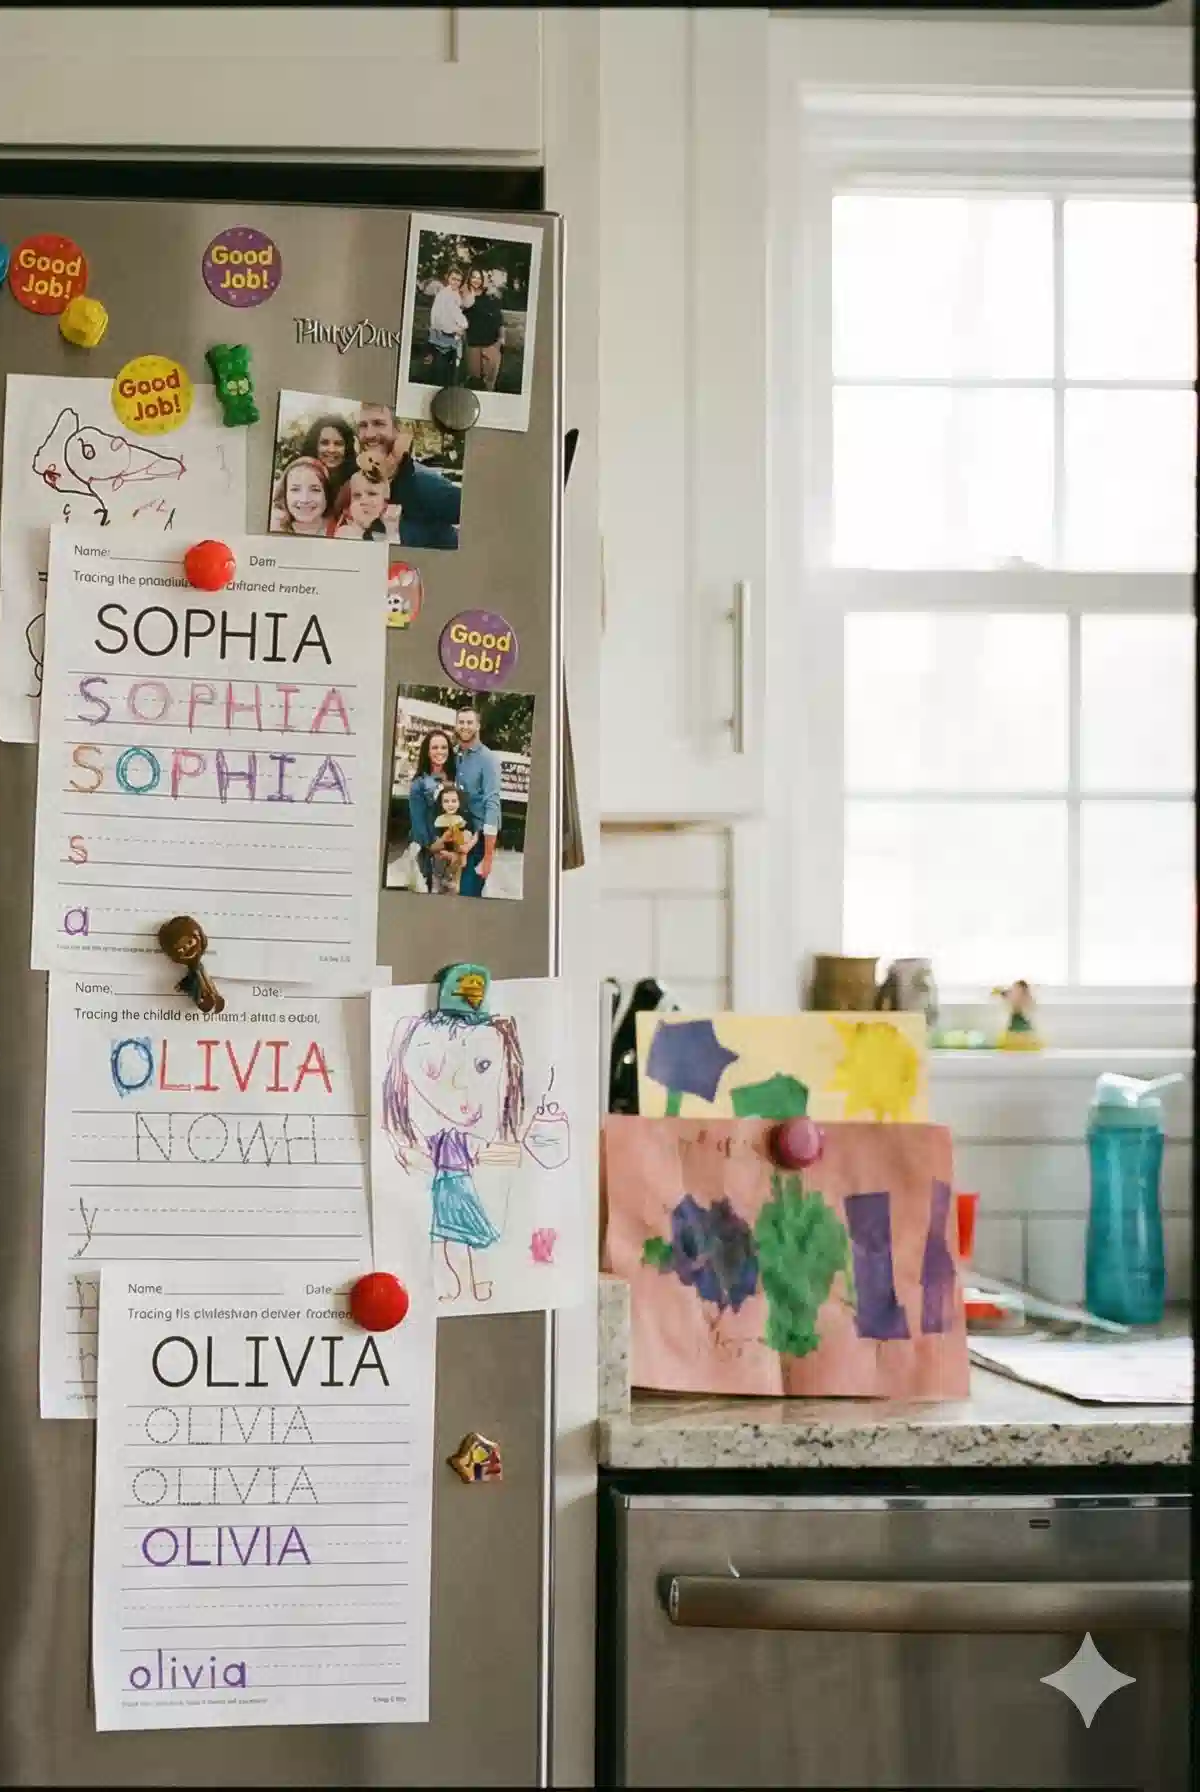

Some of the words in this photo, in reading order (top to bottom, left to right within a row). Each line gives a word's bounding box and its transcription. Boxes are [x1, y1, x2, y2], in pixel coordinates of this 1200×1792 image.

[17, 246, 82, 277] Good
[210, 245, 273, 267] Good
[20, 272, 72, 300] Job!
[218, 267, 269, 291] Job!
[118, 372, 181, 397] Good
[133, 394, 183, 422] Job!
[74, 545, 110, 557] Name:
[73, 570, 115, 586] Tracing
[94, 603, 333, 665] SOPHIA
[450, 623, 513, 653] Good
[453, 648, 502, 675] Job!
[76, 676, 355, 735] SOPHIA
[69, 744, 355, 805] SOPHIA
[63, 906, 90, 937] a
[252, 986, 283, 998] Date:
[75, 1007, 118, 1023] Tracing
[121, 1008, 140, 1021] the
[111, 1036, 335, 1096] OLIVIA
[128, 1284, 163, 1295] Name
[306, 1285, 332, 1295] Date
[128, 1308, 173, 1322] Tracing
[152, 1335, 390, 1388] OLIVIA
[144, 1405, 315, 1445] OLIVIA
[132, 1465, 319, 1506] OLIVIA
[141, 1526, 312, 1567] OLIVIA
[129, 1647, 247, 1689] olivia
